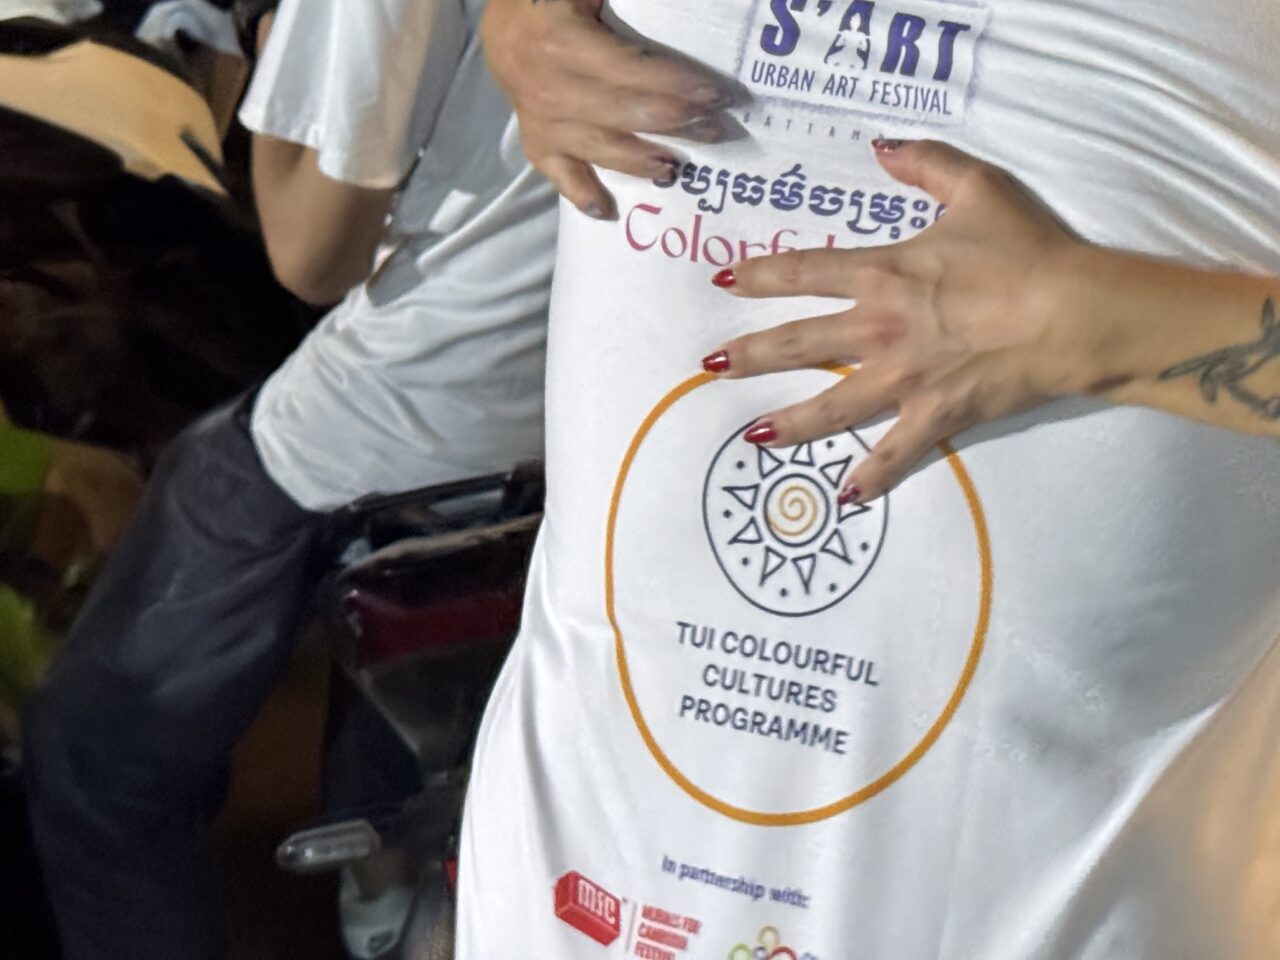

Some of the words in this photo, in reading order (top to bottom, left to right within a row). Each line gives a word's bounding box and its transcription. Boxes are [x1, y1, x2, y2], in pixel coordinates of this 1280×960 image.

[751, 60, 815, 92] URBAN
[821, 76, 860, 98] ART
[869, 84, 953, 116] FESTIVAL
[676, 621, 714, 648] TUI
[720, 631, 879, 687] COLOURFUL
[702, 663, 838, 714] CULTURES
[679, 694, 850, 756] PROGRAMME
[678, 862, 766, 901] partnership
